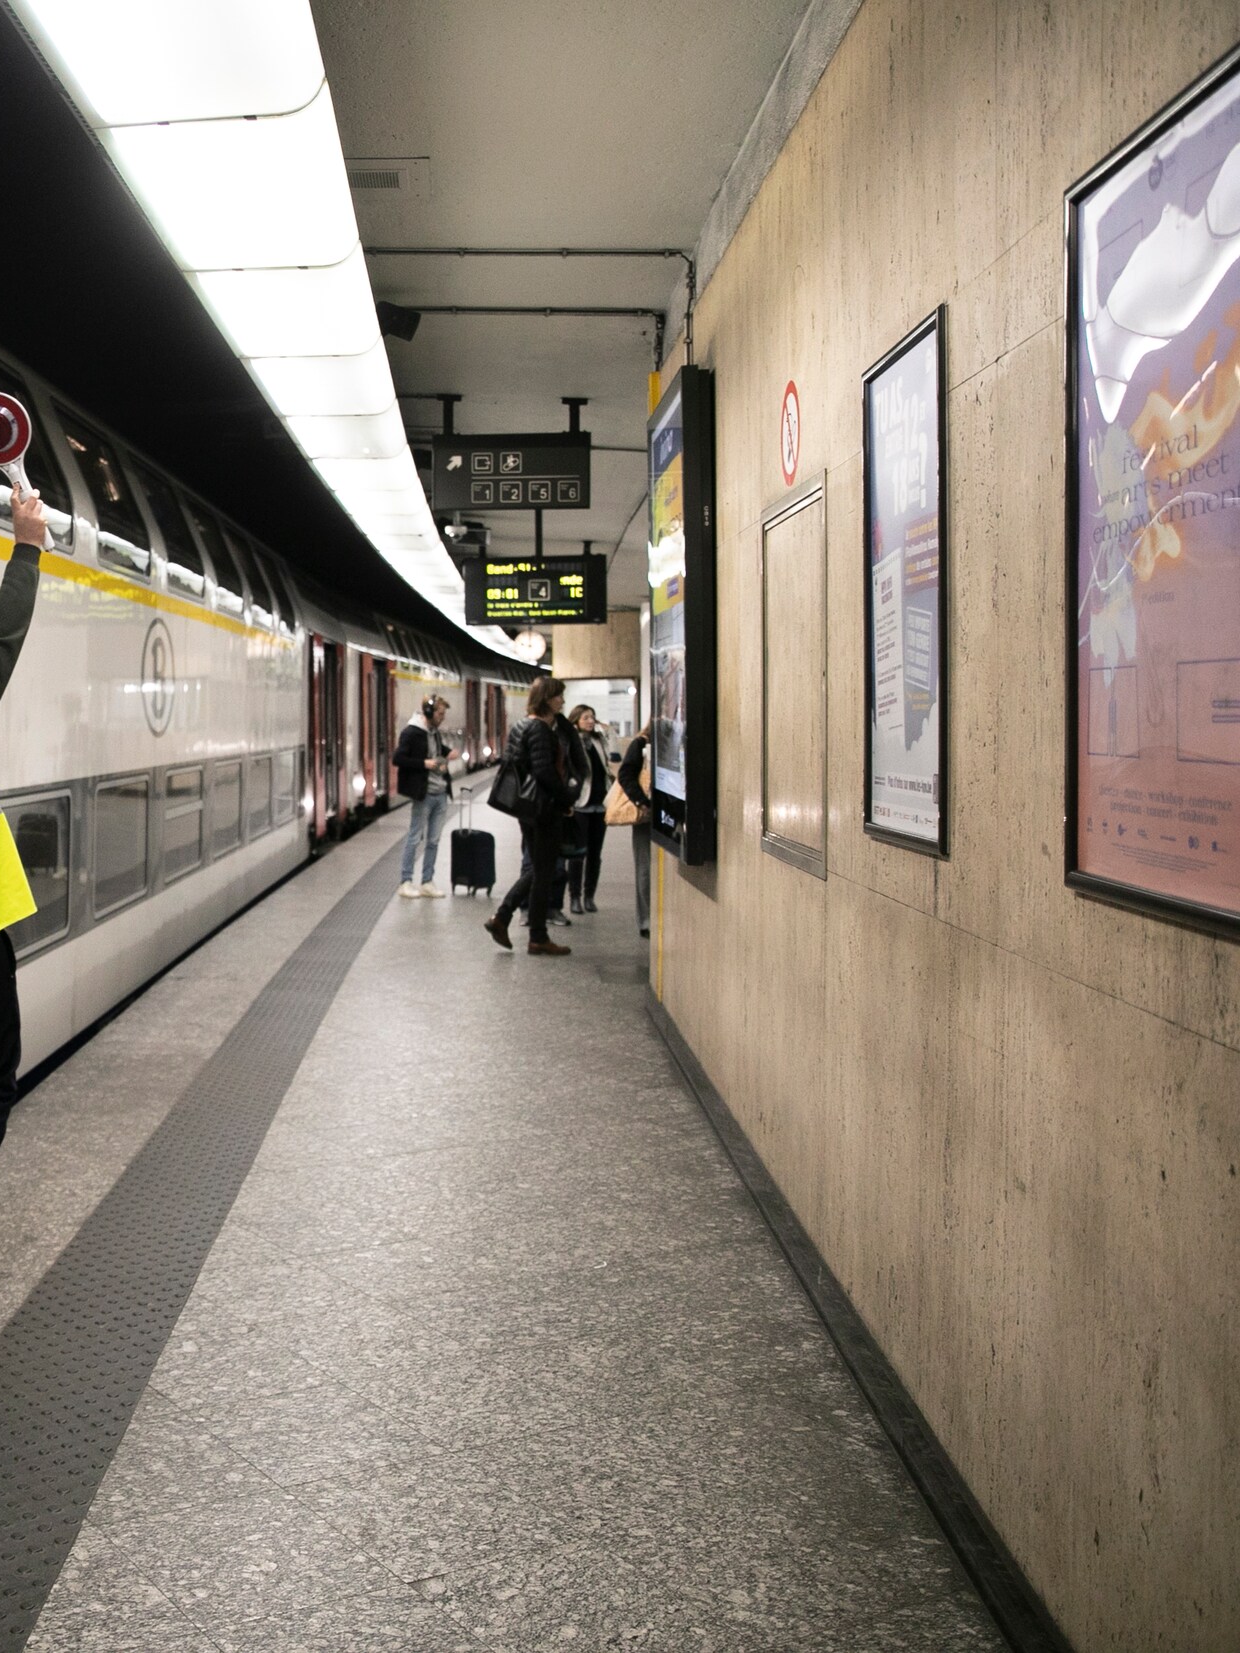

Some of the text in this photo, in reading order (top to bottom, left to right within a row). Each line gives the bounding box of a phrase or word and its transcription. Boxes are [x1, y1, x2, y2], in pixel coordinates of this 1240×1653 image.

[875, 375, 903, 437] TU AS
[1122, 425, 1199, 475] feival
[484, 489, 491, 500] 1
[510, 488, 519, 500] 2
[539, 488, 548, 499] 5
[568, 487, 577, 499] 6
[1121, 476, 1161, 505] arts
[1168, 450, 1230, 489] meet
[539, 586, 547, 598] 4
